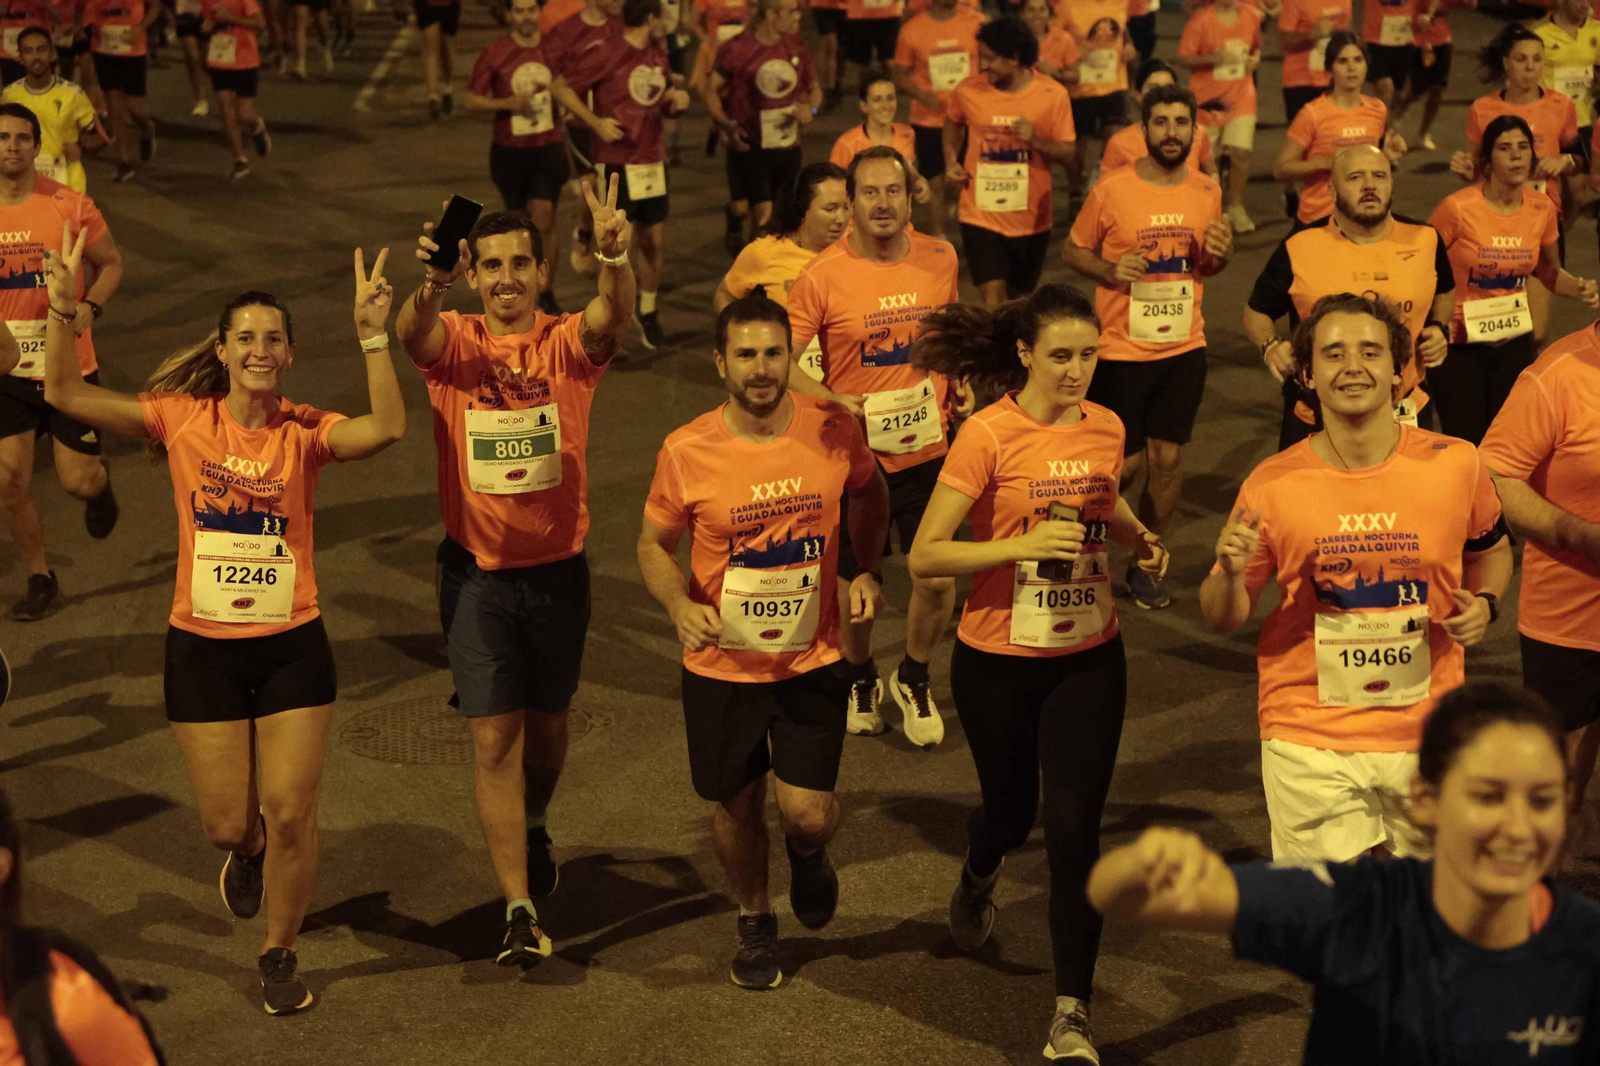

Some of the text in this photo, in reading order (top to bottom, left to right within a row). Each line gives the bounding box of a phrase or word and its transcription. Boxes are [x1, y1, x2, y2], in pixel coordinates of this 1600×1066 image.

[1150, 214, 1183, 226] XXXV
[1492, 236, 1522, 247] XXXV
[878, 292, 917, 310] XXXV
[1143, 303, 1183, 316] 20438
[870, 313, 926, 327] GUADALQUIV
[1479, 316, 1520, 333] 20445
[509, 381, 548, 391] NOCTURNA
[882, 406, 927, 431] 21248
[495, 439, 533, 458] 806
[223, 453, 269, 477] XXXV
[1047, 460, 1089, 477] XXXV
[206, 470, 284, 493] GUADALQUIVIR
[241, 476, 284, 486] NOCTURNA
[750, 476, 802, 501] XXXV
[1029, 477, 1107, 488] CARRERA NOCTURNA
[1036, 484, 1110, 498] GUADALQUIVIR
[730, 493, 822, 514] CARRERA NOCTURNA
[738, 502, 823, 523] GUADALQUIVIR
[1338, 512, 1397, 533] XXXV
[1315, 533, 1419, 545] CARRERA NOCTURNA
[1322, 542, 1419, 555] GUADALQUIVIR
[213, 565, 277, 585] 12246
[1035, 587, 1095, 608] 10936
[741, 599, 804, 617] 10937
[1339, 646, 1411, 667] 19466
